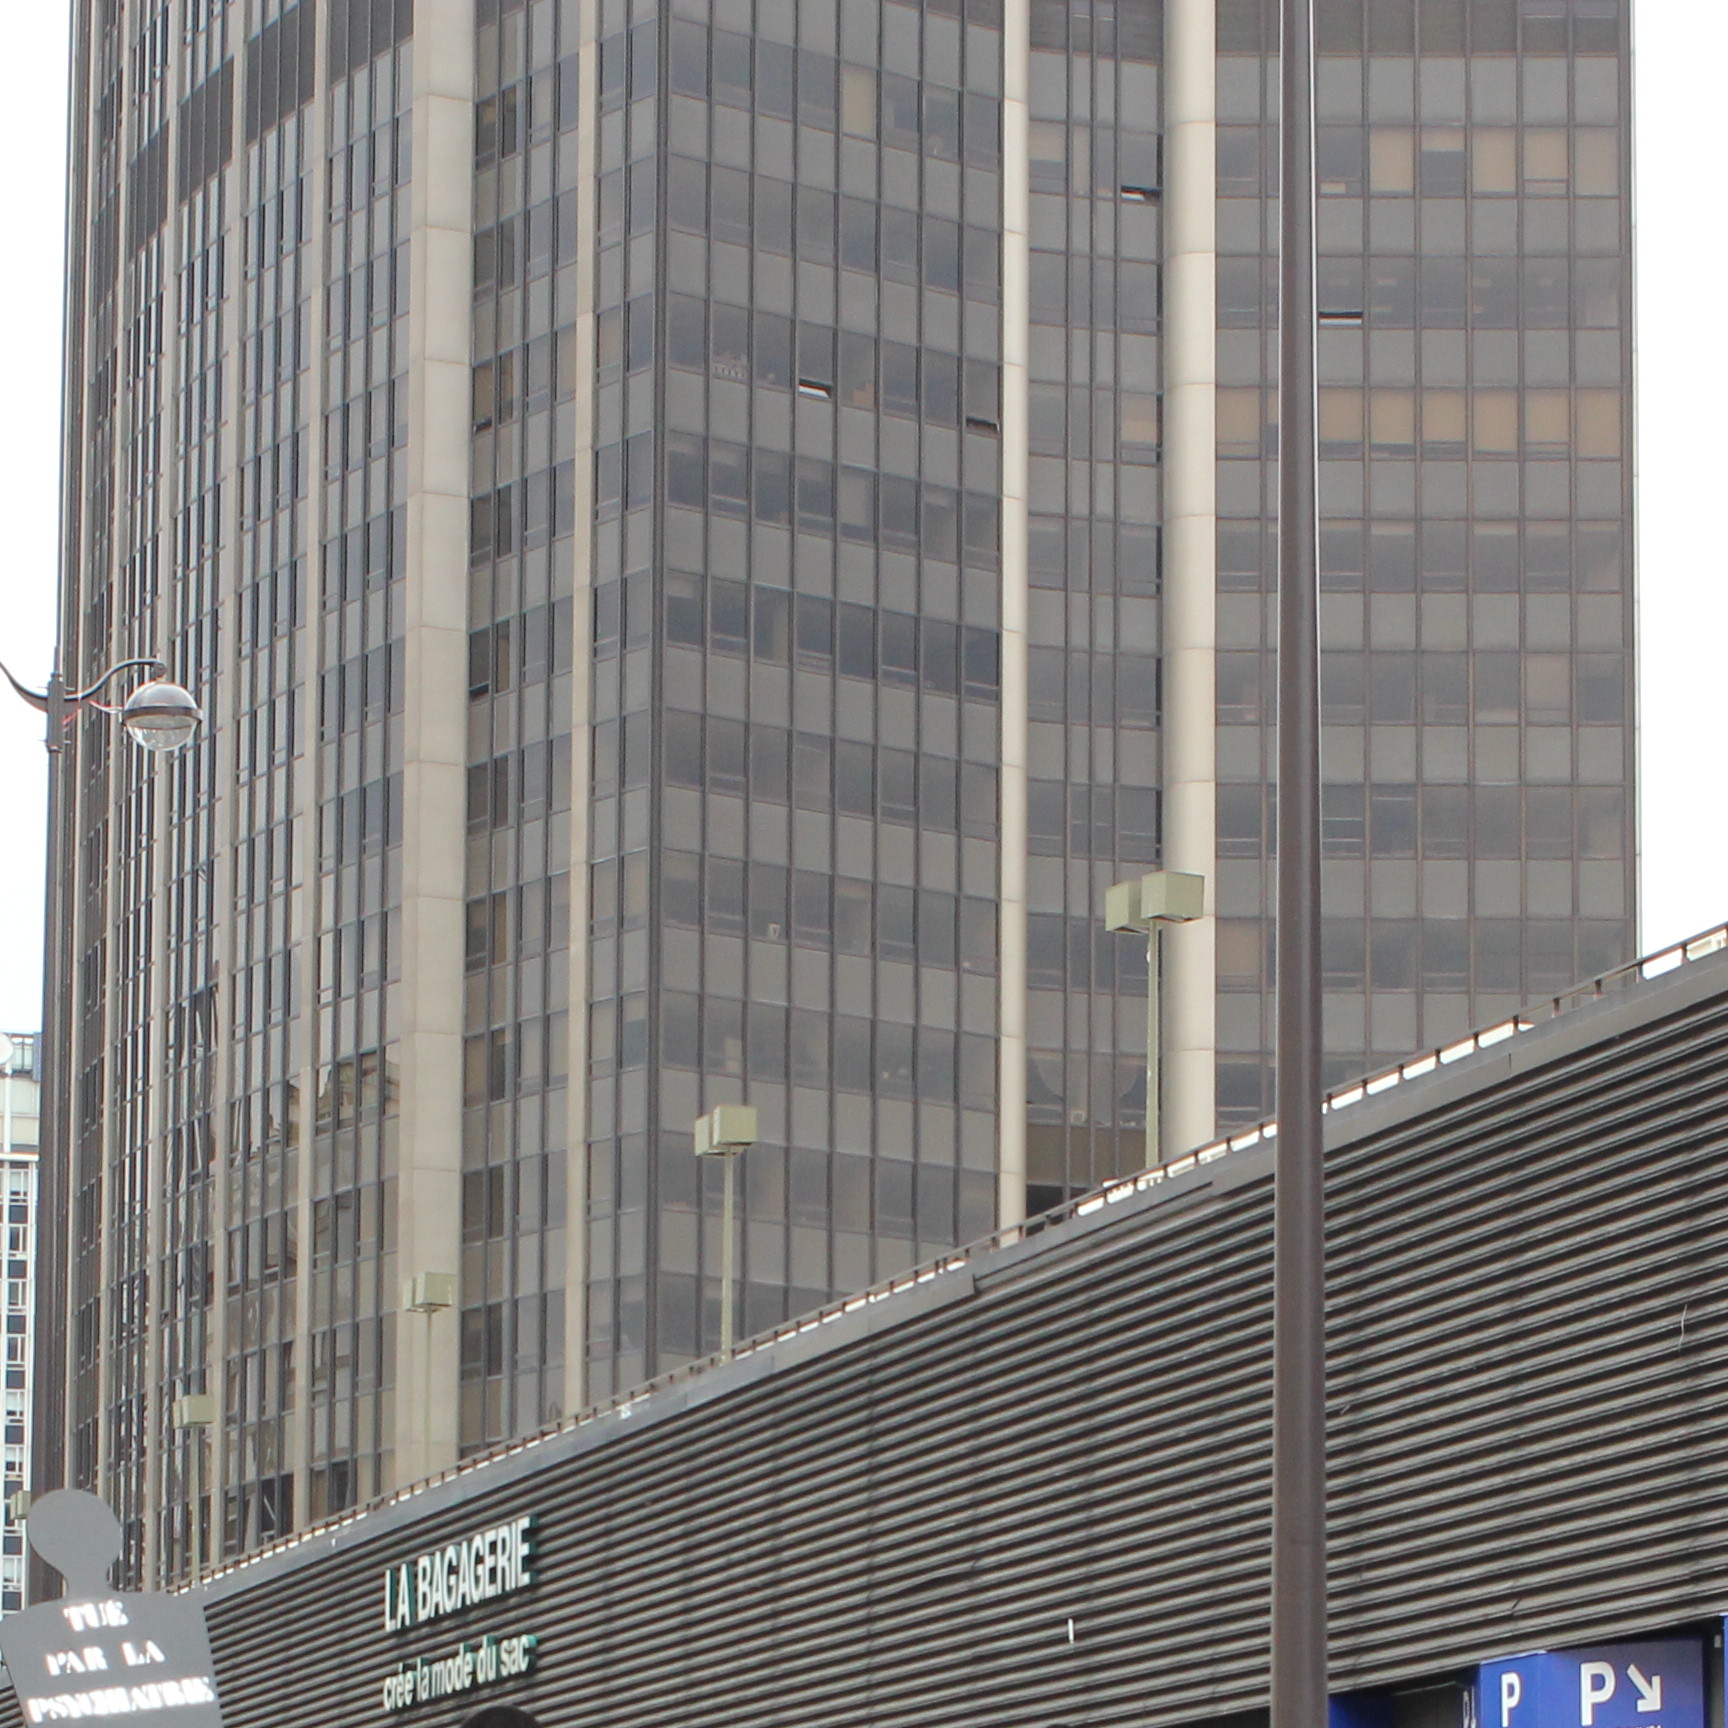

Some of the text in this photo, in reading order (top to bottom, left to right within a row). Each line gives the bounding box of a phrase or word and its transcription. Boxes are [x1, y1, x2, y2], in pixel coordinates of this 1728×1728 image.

[384, 1516, 532, 1633] LA BAGAGERIE
[45, 1639, 166, 1677] PAR LA
[416, 1656, 430, 1701] la
[431, 1642, 472, 1698] mode
[476, 1634, 498, 1684] du
[500, 1634, 532, 1678] sac
[1501, 1671, 1521, 1728] P
[1581, 1660, 1617, 1728] P
